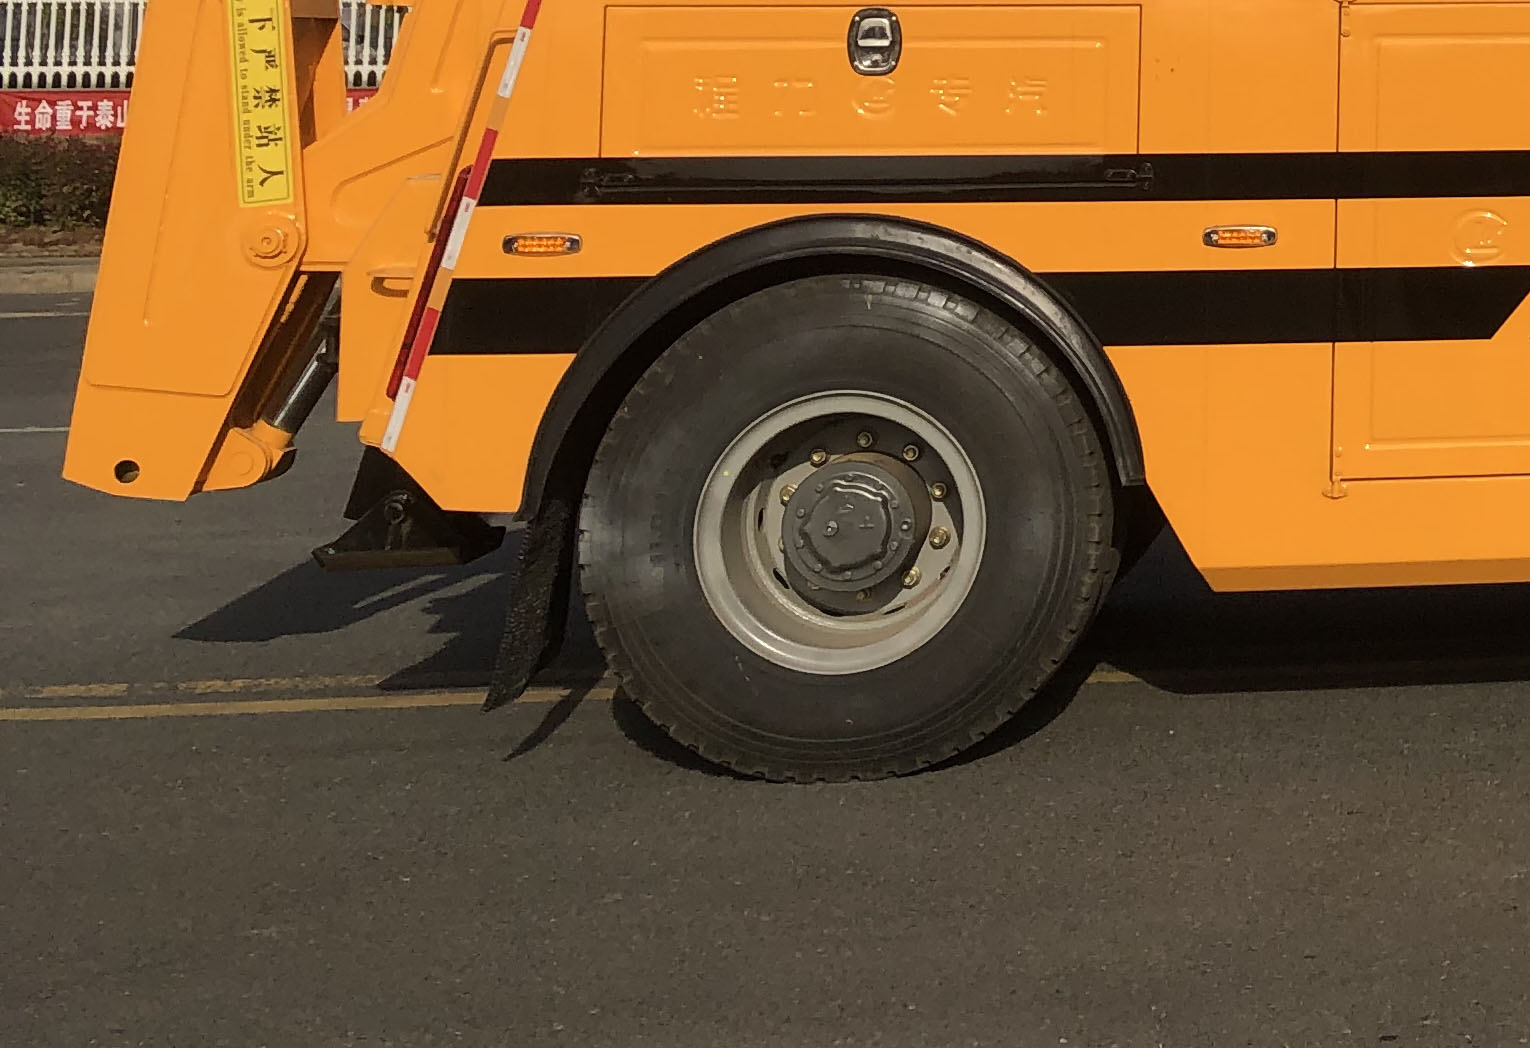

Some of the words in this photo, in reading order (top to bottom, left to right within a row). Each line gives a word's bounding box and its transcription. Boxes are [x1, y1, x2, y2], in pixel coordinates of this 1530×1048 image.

[235, 7, 243, 17] is
[236, 22, 249, 64] allowed
[239, 68, 249, 80] to
[240, 84, 252, 114] stand
[14, 98, 129, 130] 生命重于泰山
[242, 119, 253, 151] under
[244, 156, 256, 172] the
[246, 179, 255, 198] arm
